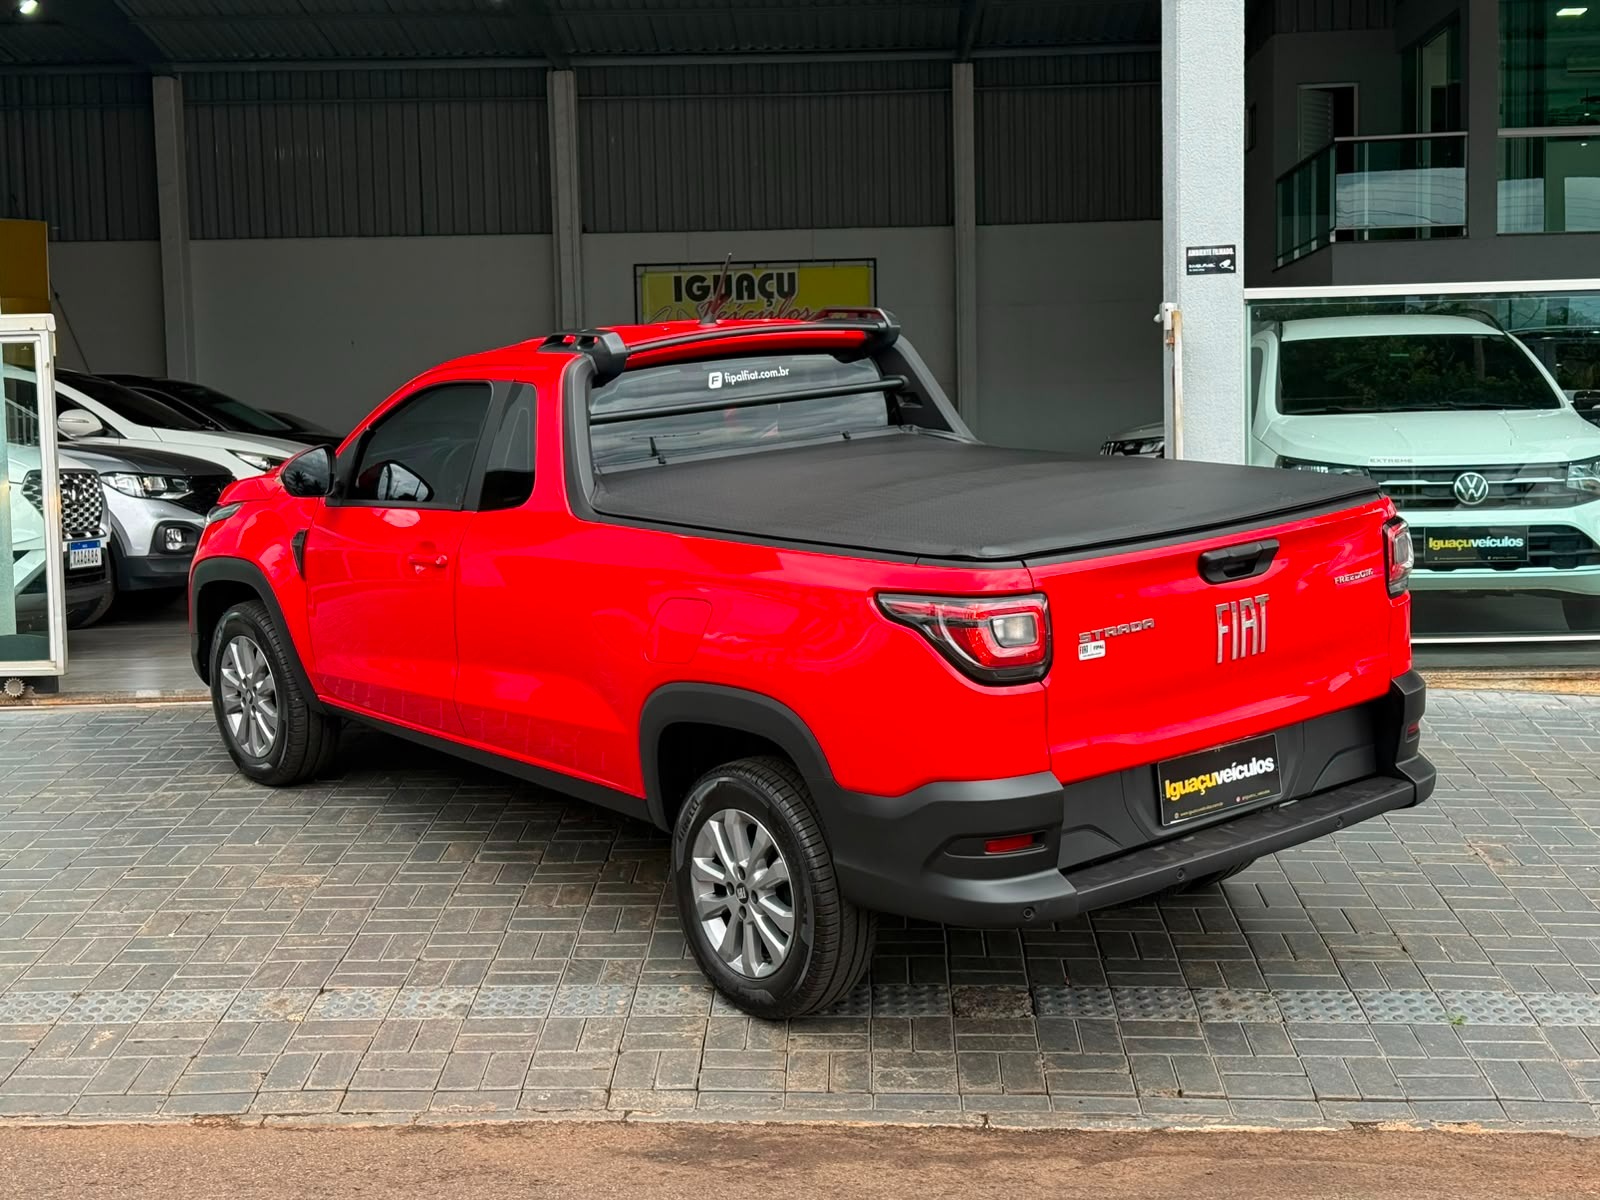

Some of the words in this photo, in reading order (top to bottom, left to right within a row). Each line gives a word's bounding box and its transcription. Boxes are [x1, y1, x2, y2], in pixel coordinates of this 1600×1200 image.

[673, 271, 797, 307] IGUAÇU
[724, 366, 790, 385] fipalfiat.com.br
[1428, 535, 1524, 551] Iguaçuveículos
[1078, 617, 1155, 644] STRADA
[1215, 593, 1271, 664] FIAT
[1164, 757, 1275, 801] Iguaçuveículos
